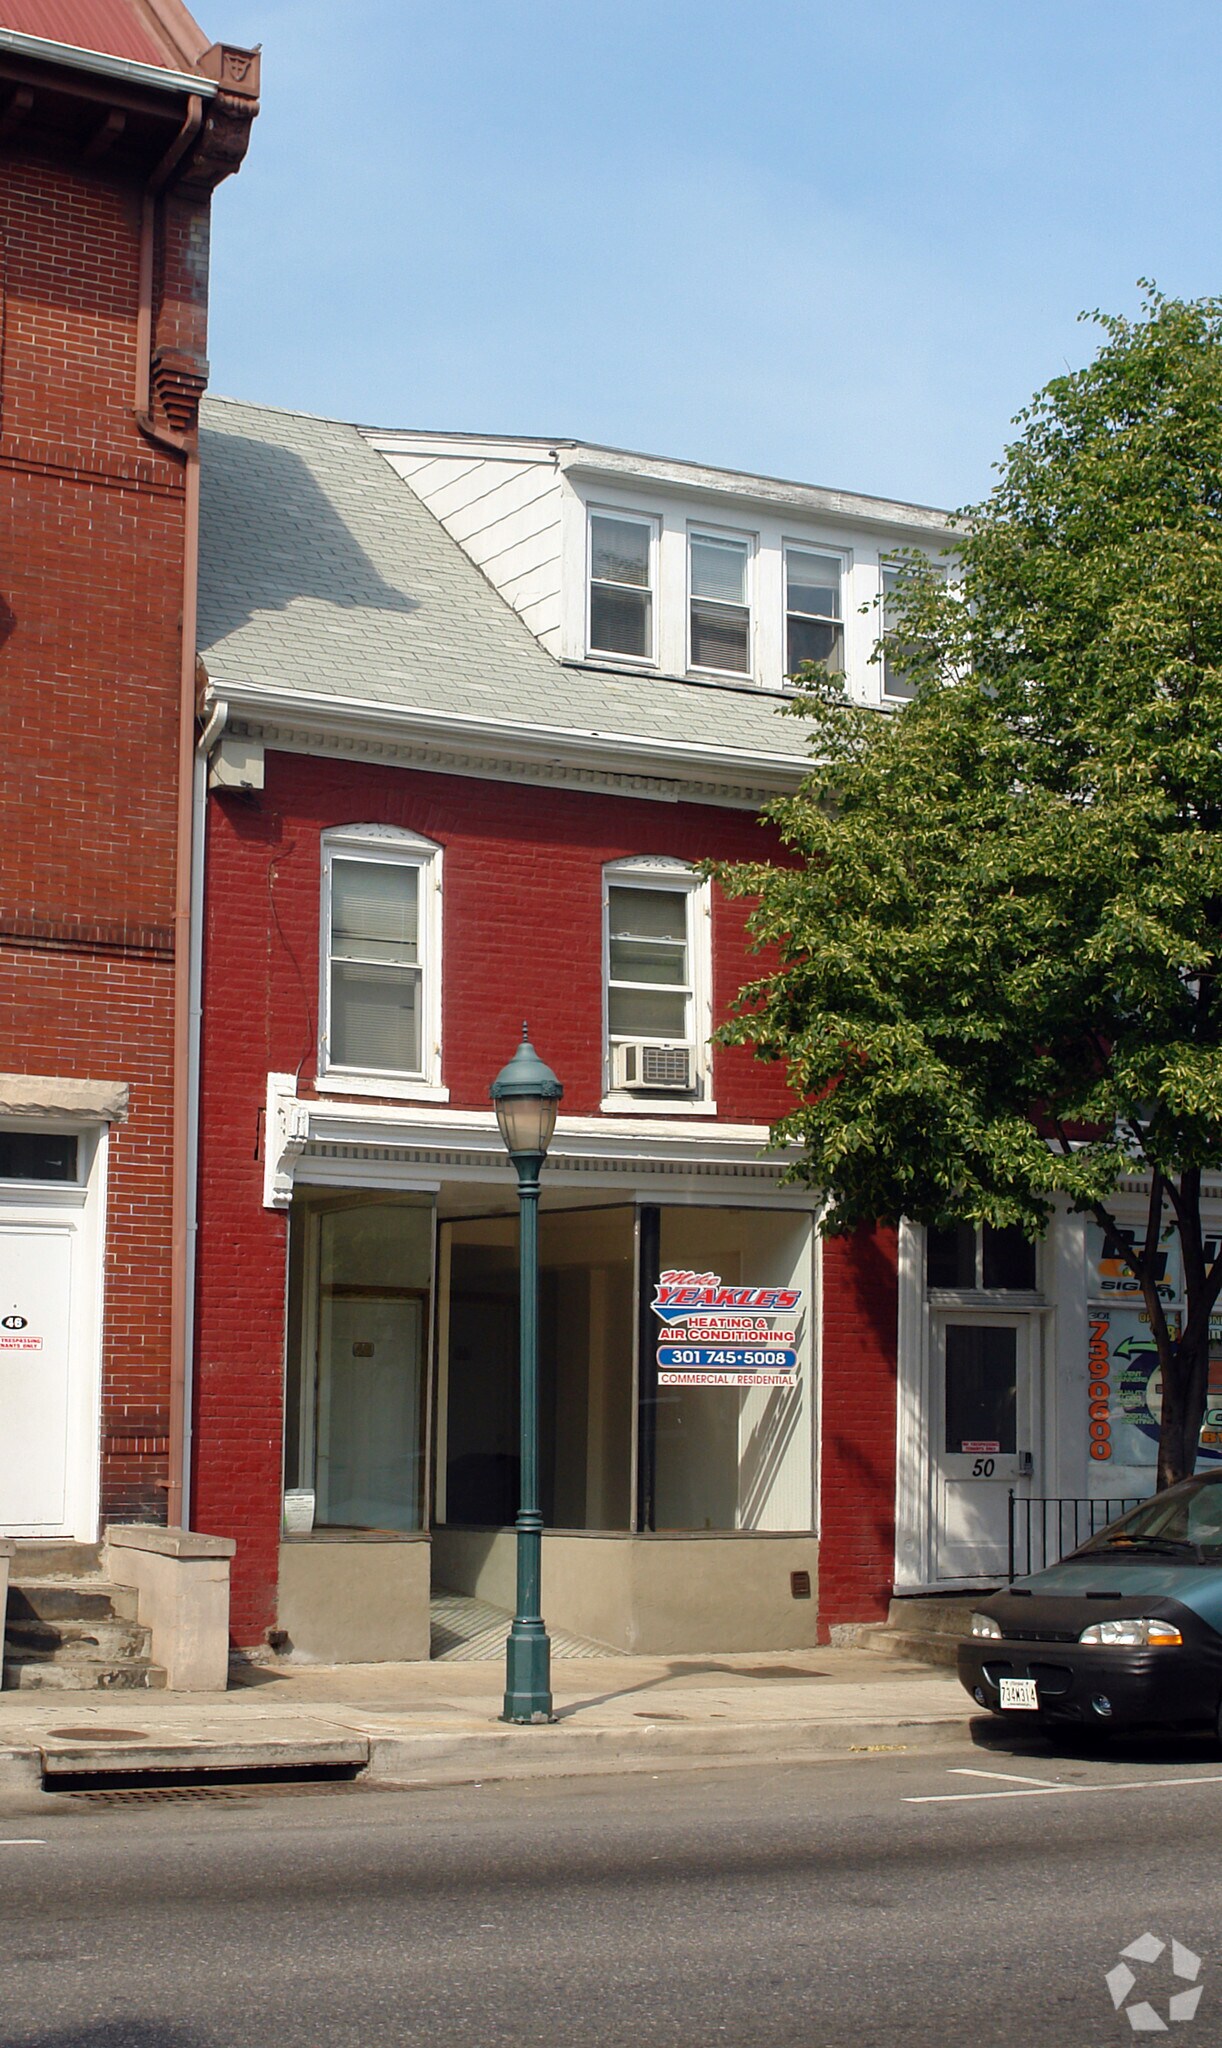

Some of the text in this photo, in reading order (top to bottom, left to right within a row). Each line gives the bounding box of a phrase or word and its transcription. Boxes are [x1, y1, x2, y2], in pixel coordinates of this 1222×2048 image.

[660, 1271, 720, 1286] Mike
[1101, 1281, 1171, 1293] SIGS
[656, 1286, 802, 1308] YEAKLE'S
[688, 1318, 767, 1328] HEATING &
[660, 1330, 794, 1341] AIR CONDITIONING
[671, 1350, 700, 1363] 301
[661, 1374, 729, 1384] COMMERCIAL
[737, 1375, 794, 1385] RESIDENTIAL
[972, 1458, 995, 1477] 50
